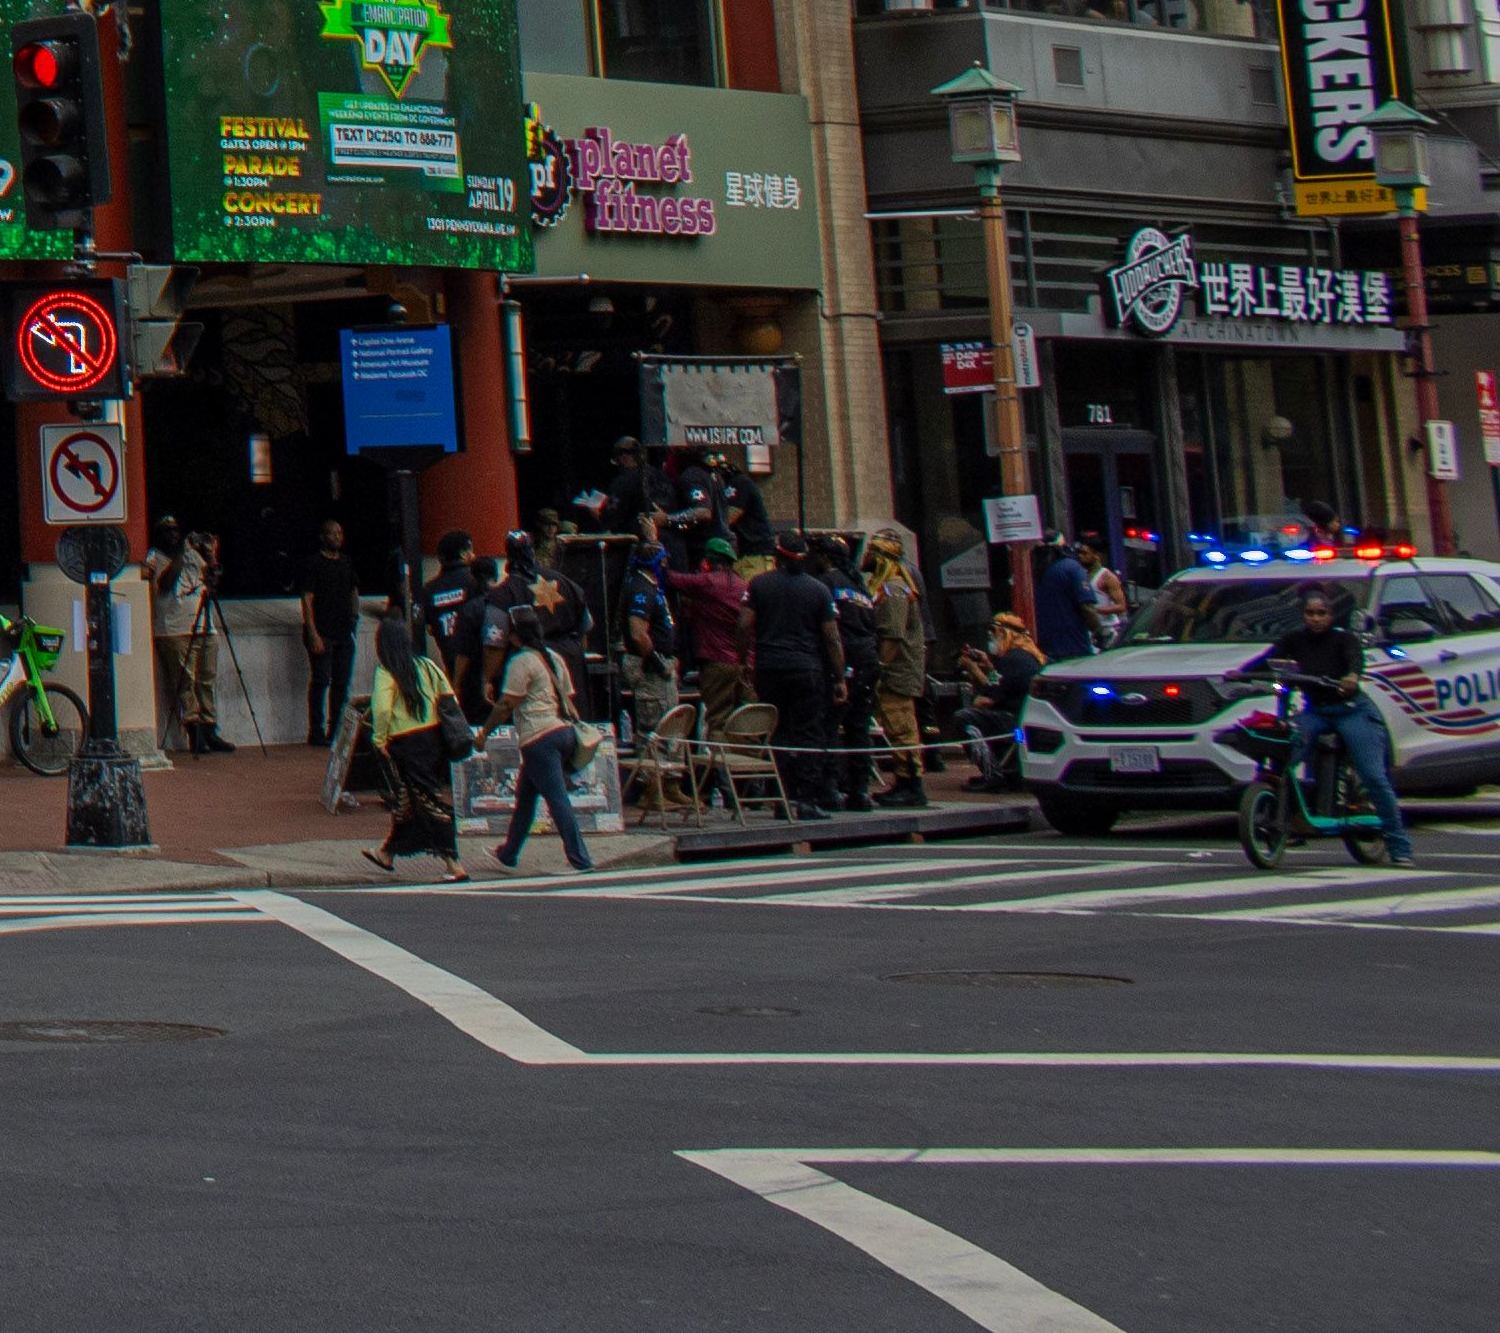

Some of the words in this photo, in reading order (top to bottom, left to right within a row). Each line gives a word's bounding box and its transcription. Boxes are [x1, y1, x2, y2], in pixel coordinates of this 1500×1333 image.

[364, 29, 419, 66] DAY
[220, 116, 311, 140] FESTIVAL
[334, 127, 363, 141] TEXT
[405, 131, 418, 144] TO
[419, 132, 454, 147] 888-777
[220, 139, 251, 151] GATES
[253, 139, 278, 151] OPEN
[288, 140, 306, 152] 1PM
[576, 127, 693, 191] planet
[222, 154, 301, 177] PARADE
[529, 155, 557, 198] pf
[222, 192, 322, 215] CONCERT
[466, 174, 496, 190] SUNDAY
[497, 176, 517, 214] 19
[466, 189, 498, 212] APRIL
[724, 170, 801, 211] 星球健身
[234, 216, 276, 228] 2:30PM
[594, 179, 717, 236] fitness
[1201, 261, 1393, 325] 世界上最好漢堡
